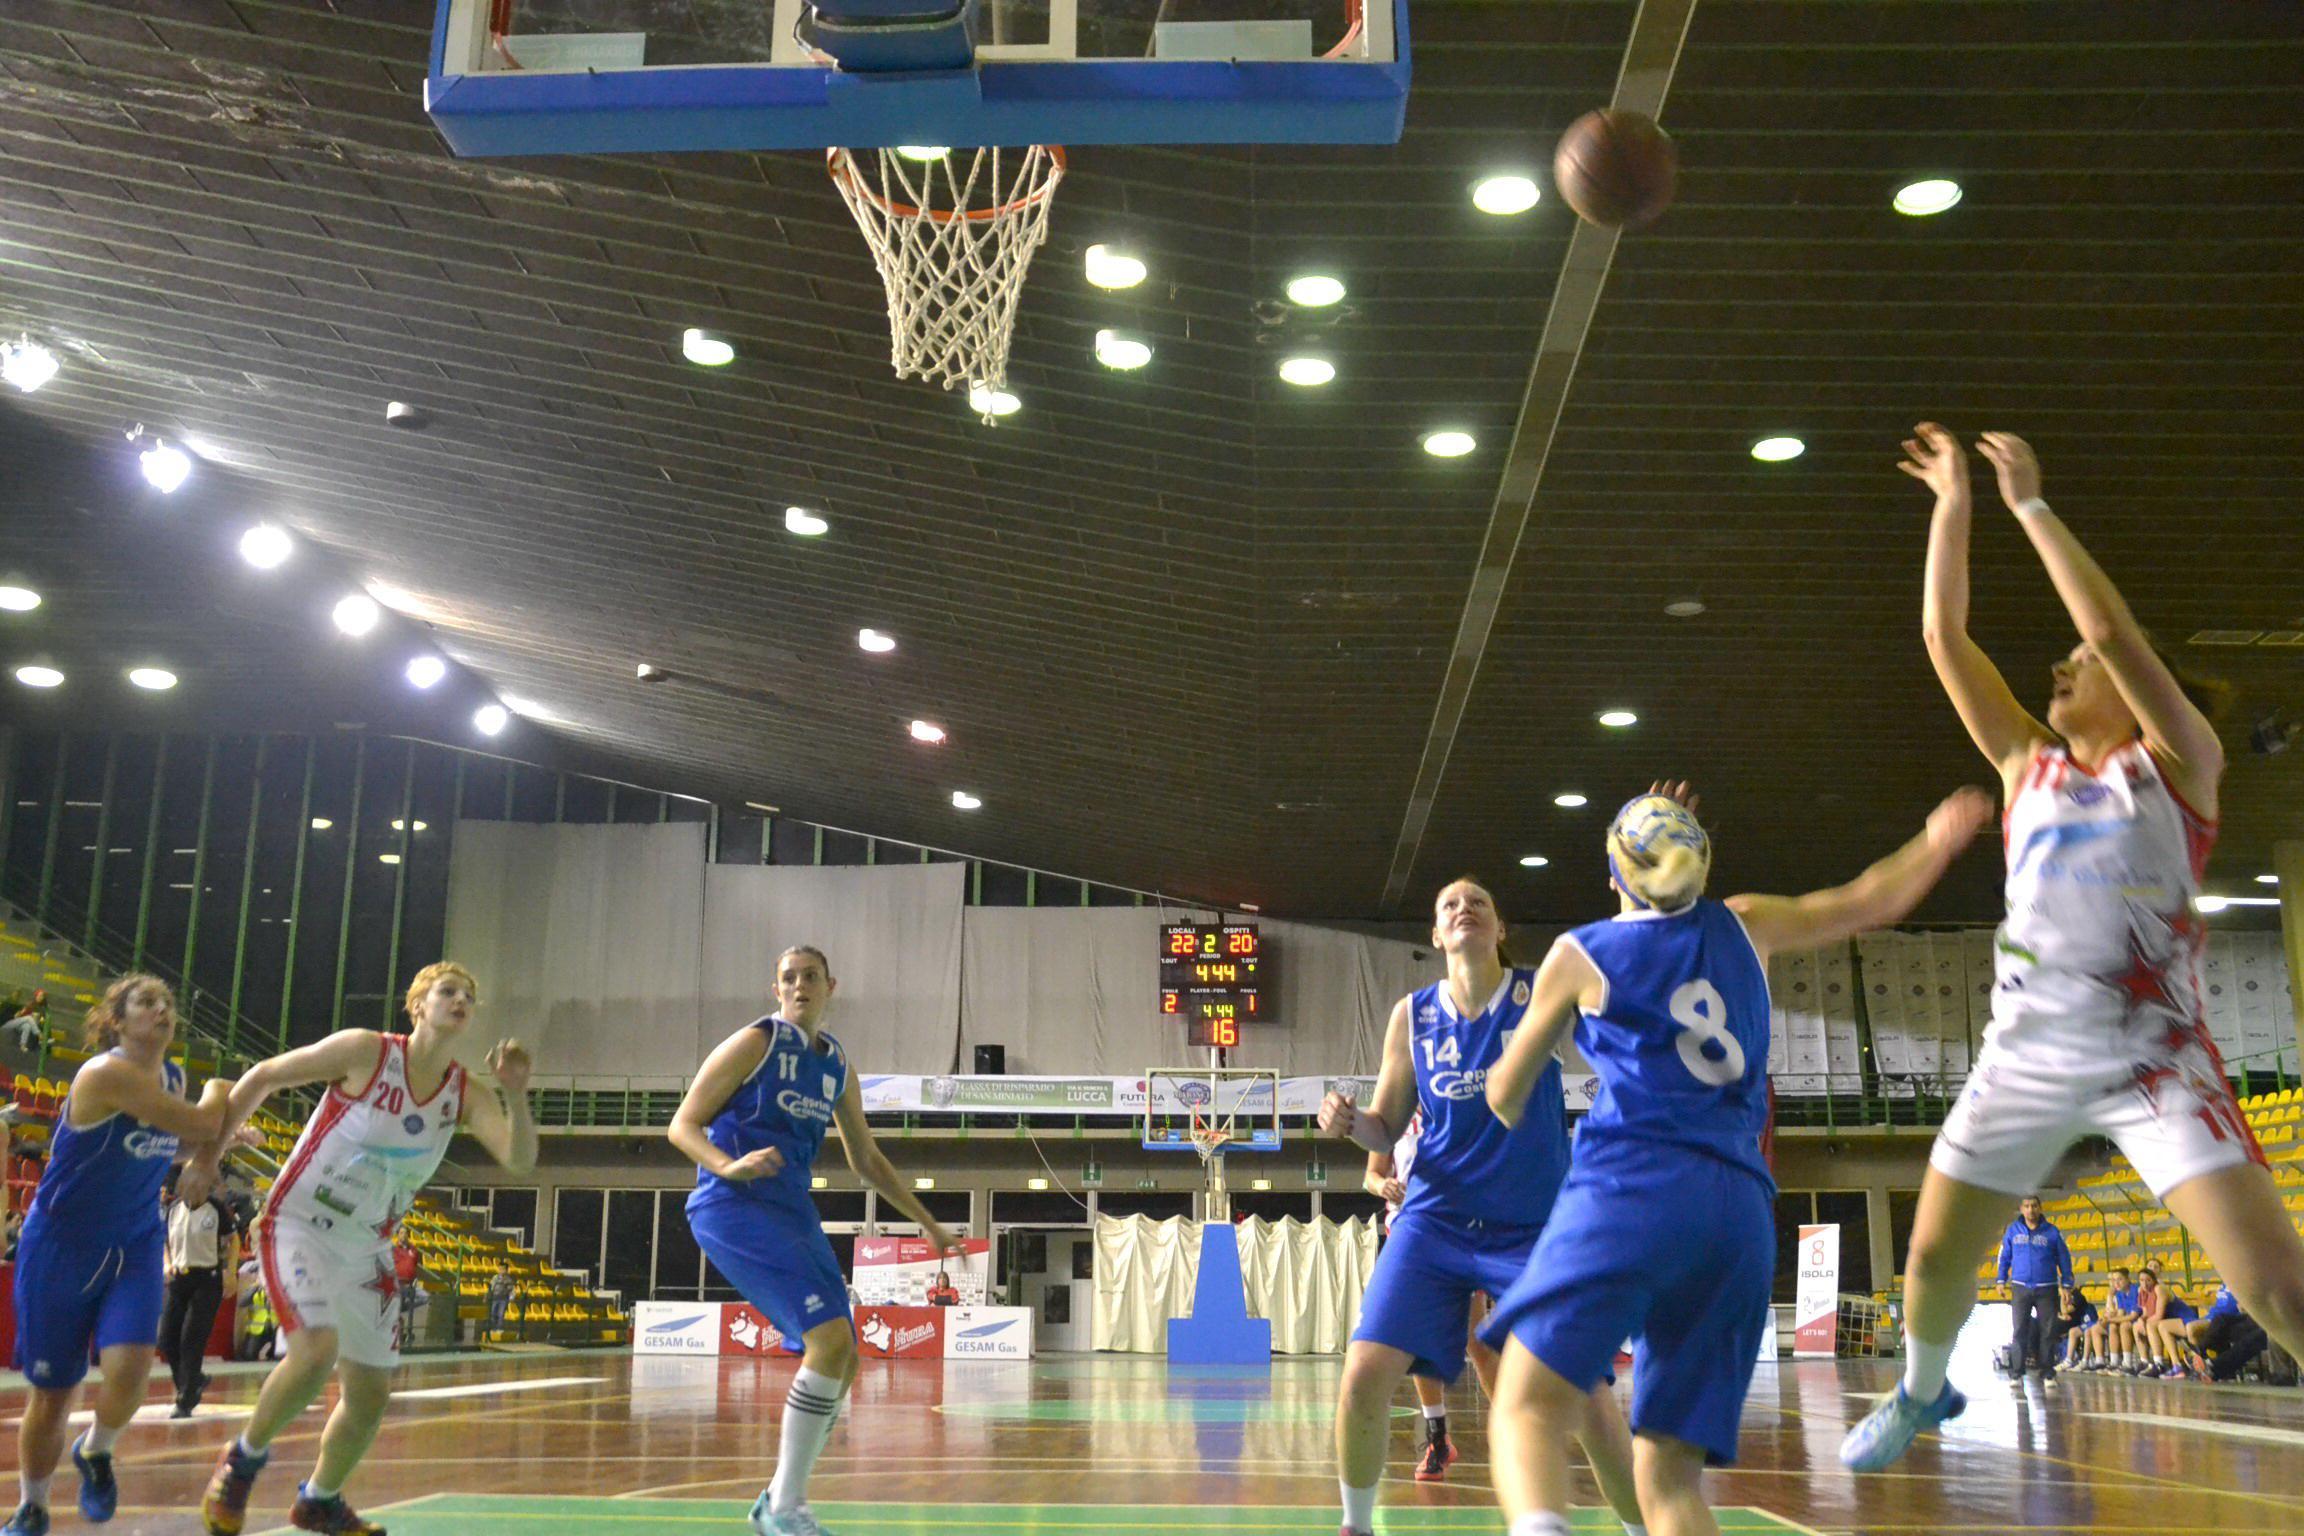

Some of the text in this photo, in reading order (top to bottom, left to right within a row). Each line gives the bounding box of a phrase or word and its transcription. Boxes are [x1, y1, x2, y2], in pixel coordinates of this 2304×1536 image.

[1171, 934, 1253, 953] 22 2 20
[1165, 994, 1255, 1013] 2 1
[1213, 1018, 1235, 1045] 16
[1669, 978, 1745, 1086] 8
[1421, 1036, 1462, 1071] 14
[778, 1052, 799, 1082] 11
[961, 1082, 992, 1091] CASSA
[1004, 1083, 1055, 1092] RISPARMIO
[961, 1091, 971, 1099] DI
[993, 1092, 1034, 1100] MINIATO
[1067, 1091, 1107, 1102] LUCCA
[373, 1081, 404, 1115] 20
[1801, 1270, 1834, 1278] ISOLA
[644, 1336, 705, 1347] GESAM Gas
[955, 1341, 1017, 1352] GESAM Gas
